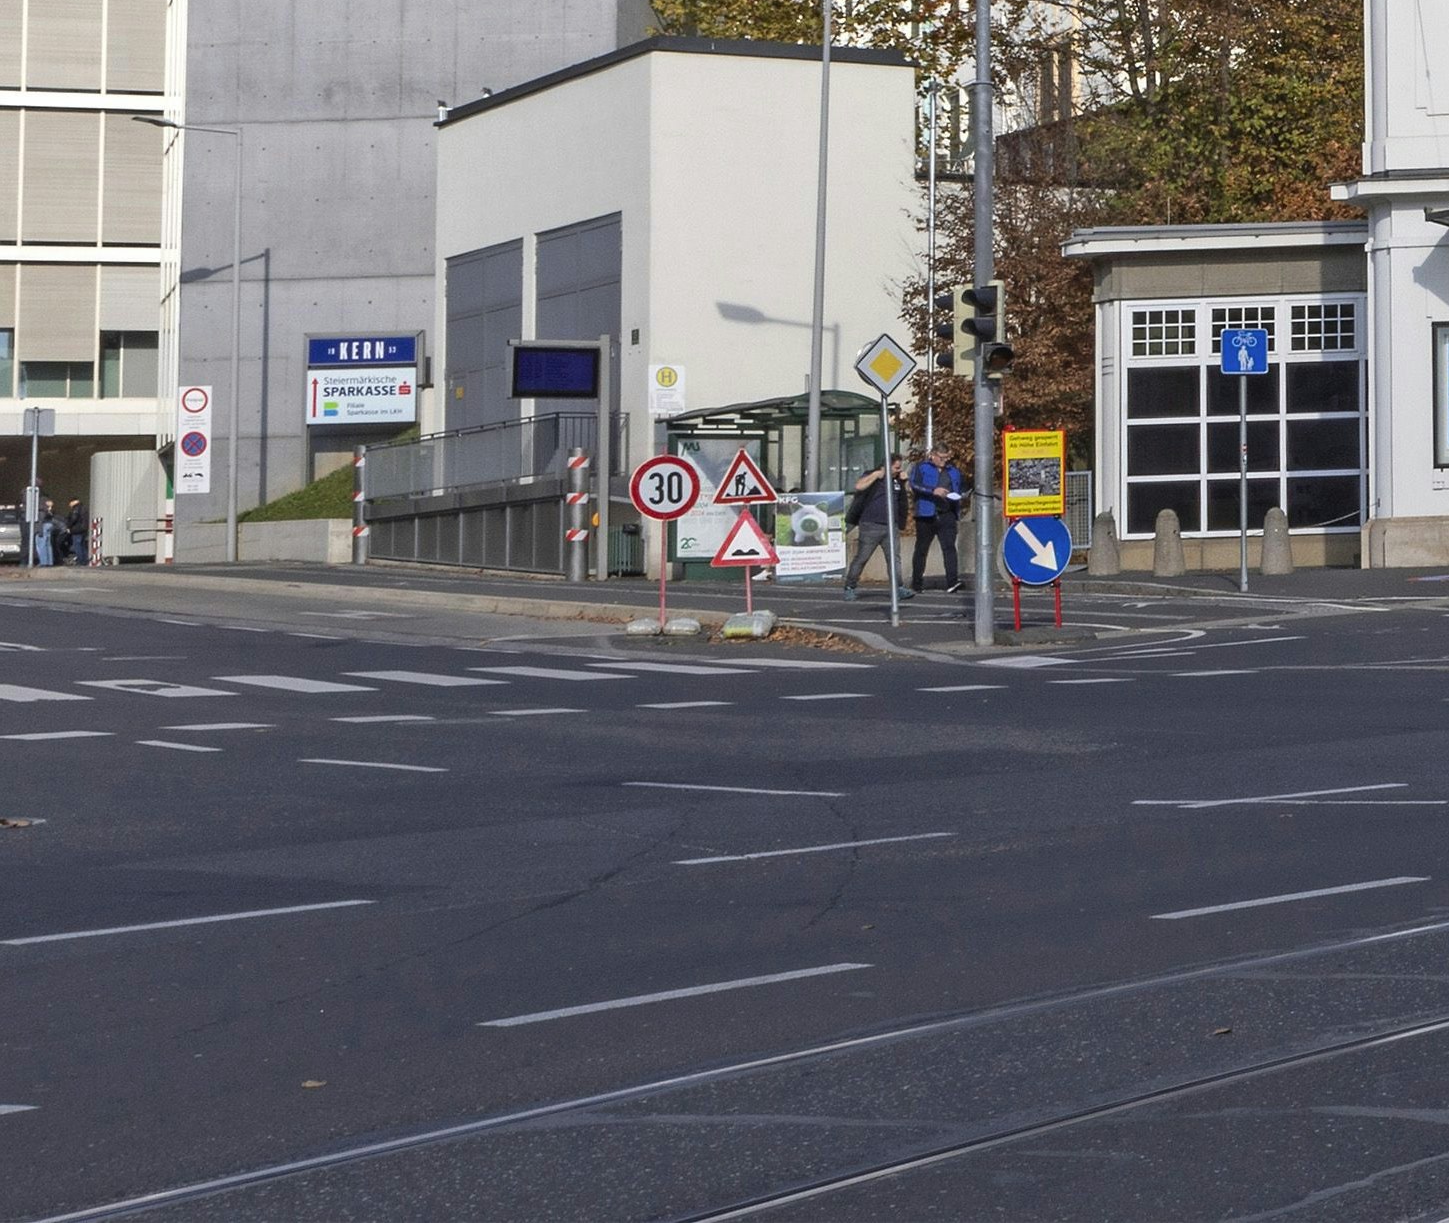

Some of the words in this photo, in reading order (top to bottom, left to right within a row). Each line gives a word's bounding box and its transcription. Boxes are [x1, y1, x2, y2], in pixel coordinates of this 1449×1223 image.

[339, 341, 384, 360] KERN
[323, 376, 397, 385] Steiermärkische
[323, 385, 396, 397] SPARKASSE
[649, 472, 683, 505] 30
